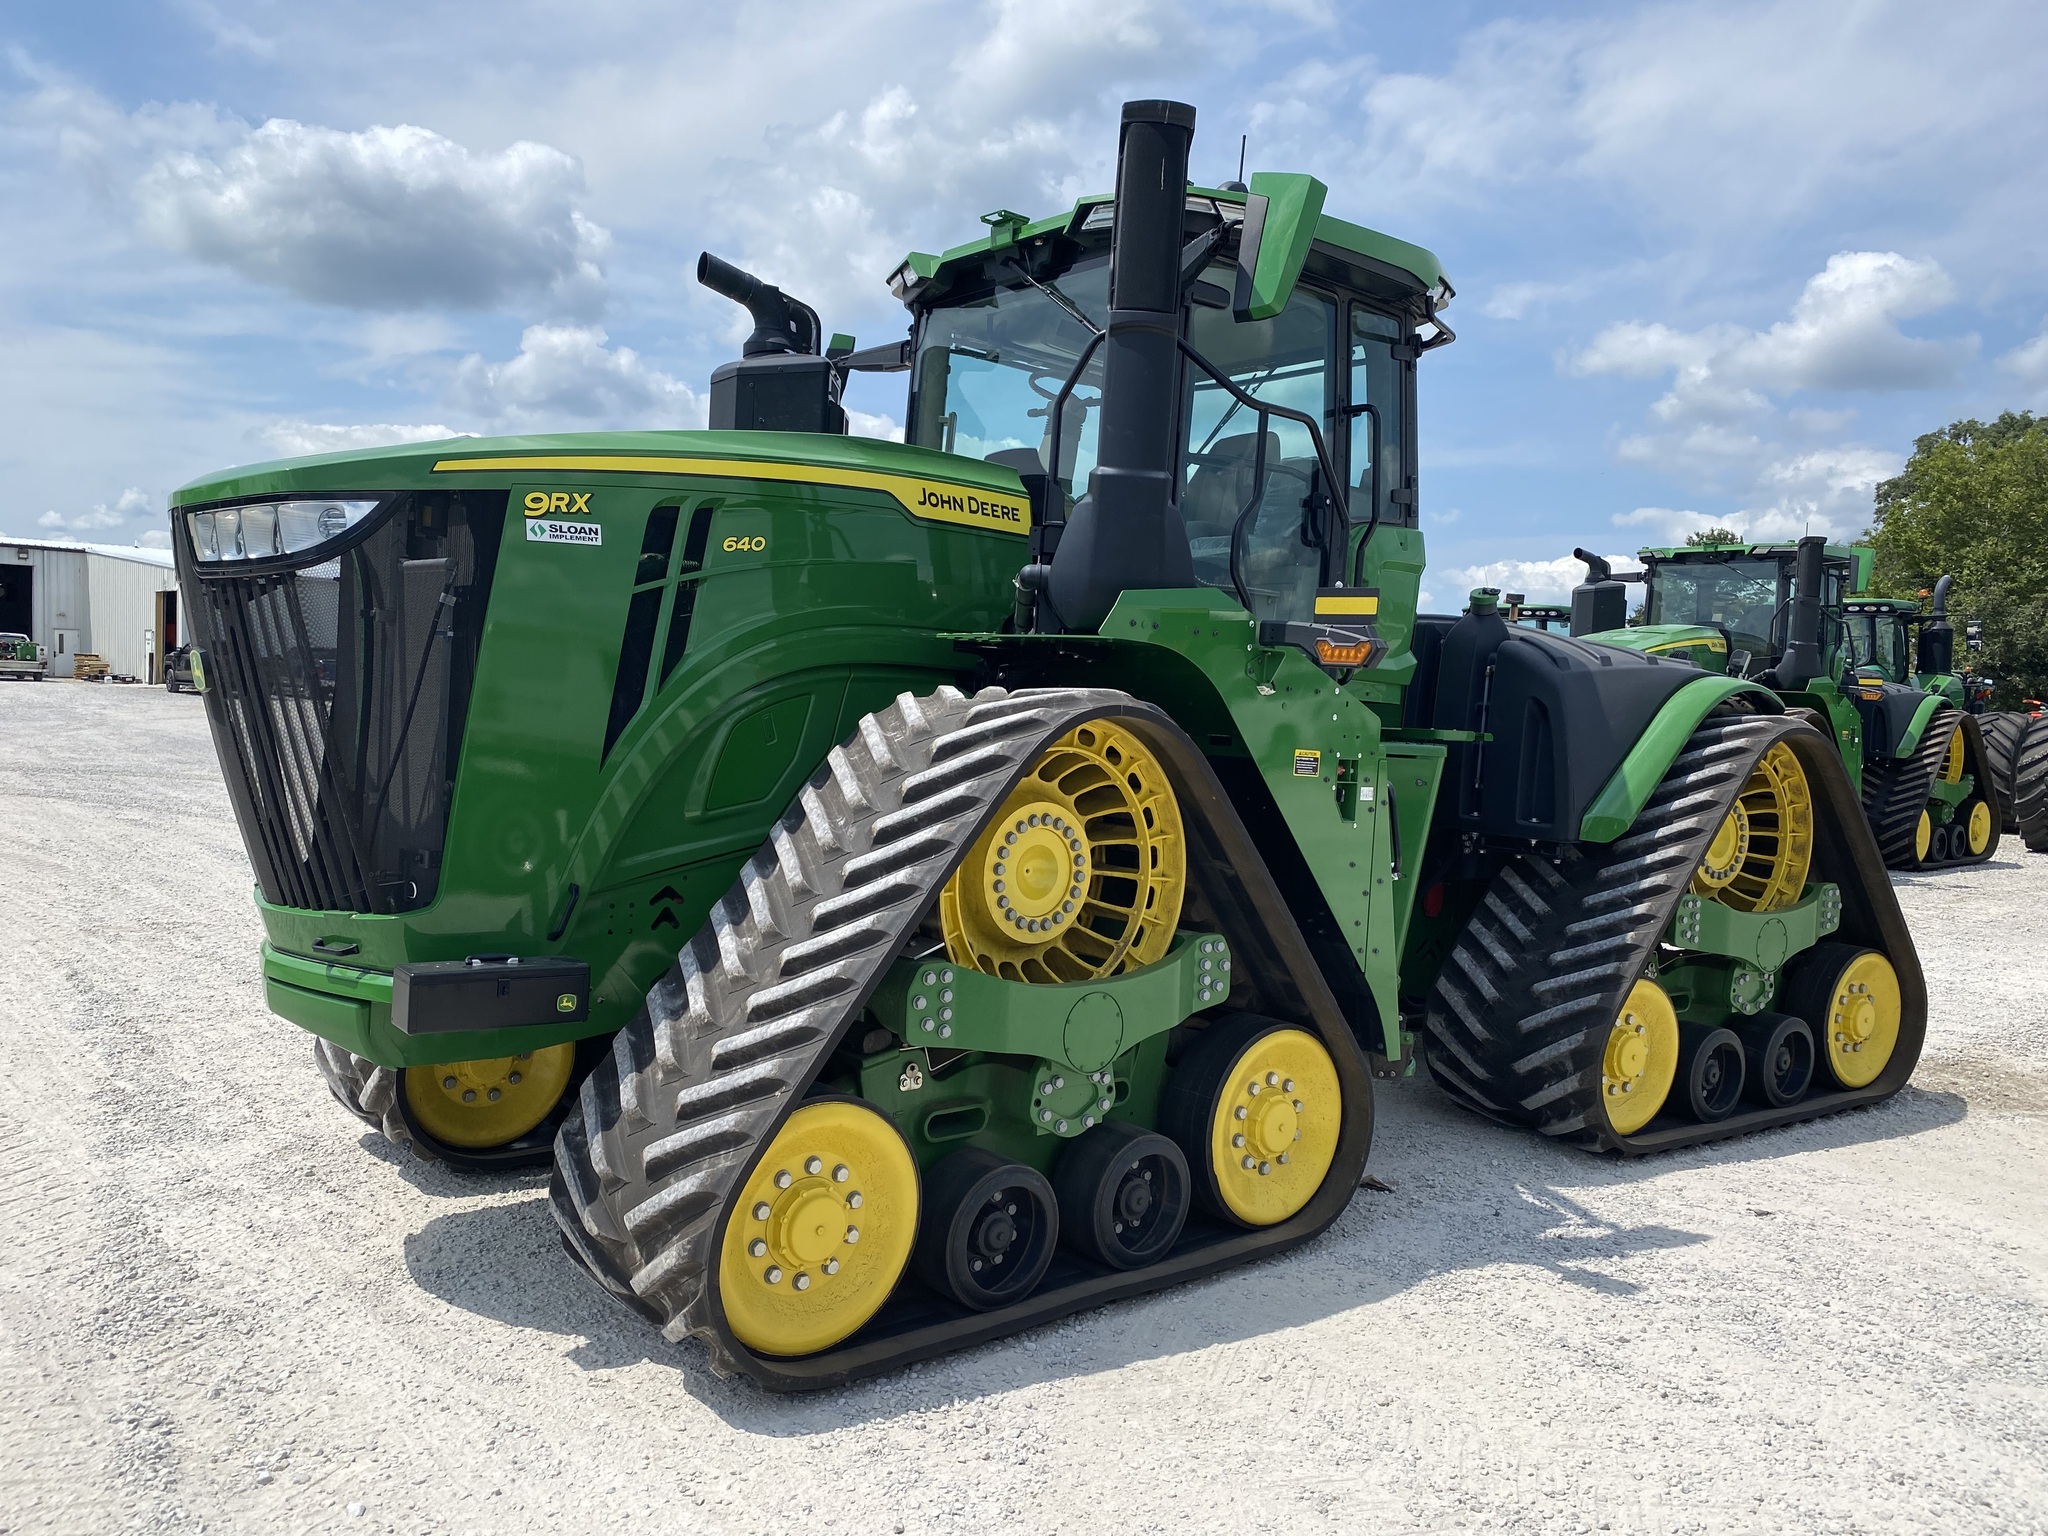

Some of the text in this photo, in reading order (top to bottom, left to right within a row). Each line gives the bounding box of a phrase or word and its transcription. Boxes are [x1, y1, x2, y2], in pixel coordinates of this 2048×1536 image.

[524, 491, 593, 517] 9RX
[918, 487, 1020, 522] JOHN DEERE
[549, 524, 598, 536] SLOAN
[549, 533, 599, 542] IMPLEMENT
[722, 536, 766, 552] 640
